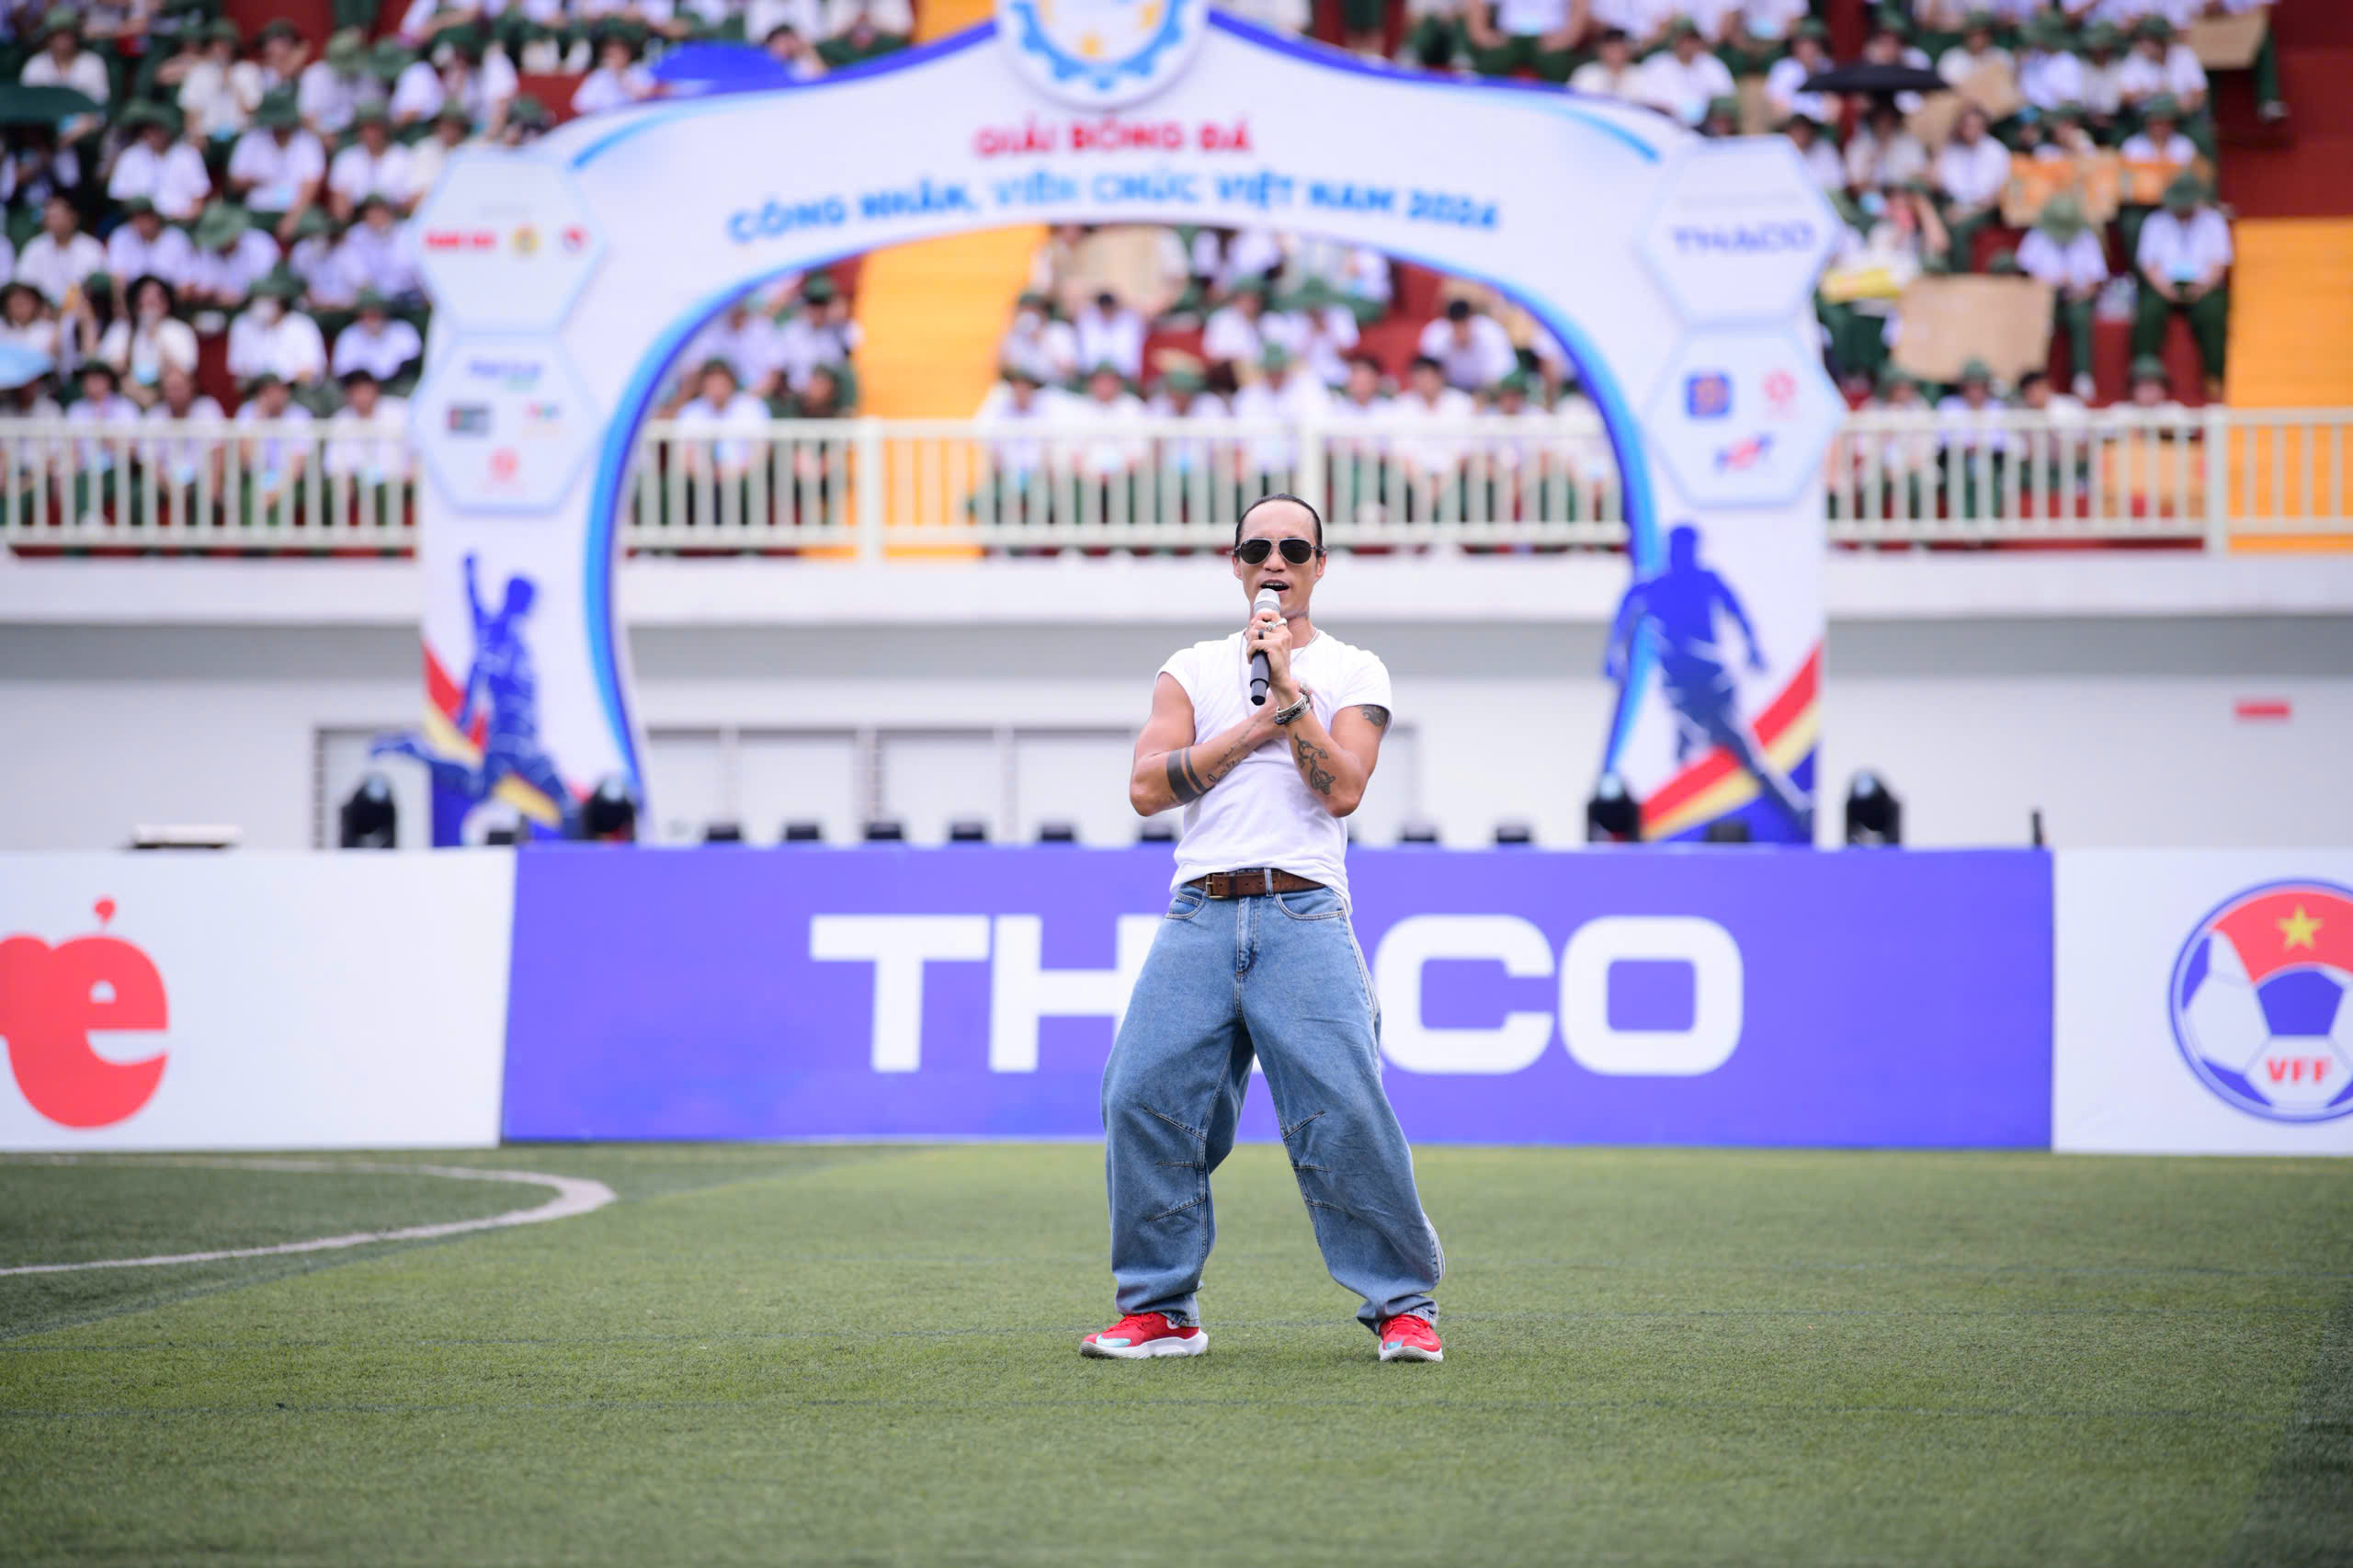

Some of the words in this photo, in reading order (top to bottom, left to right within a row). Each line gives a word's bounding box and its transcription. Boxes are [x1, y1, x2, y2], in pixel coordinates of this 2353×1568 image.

[729, 195, 847, 242] CÔNG
[1309, 181, 1395, 213] NAM
[810, 914, 1745, 1076] THCO
[2268, 1056, 2331, 1083] VFF
